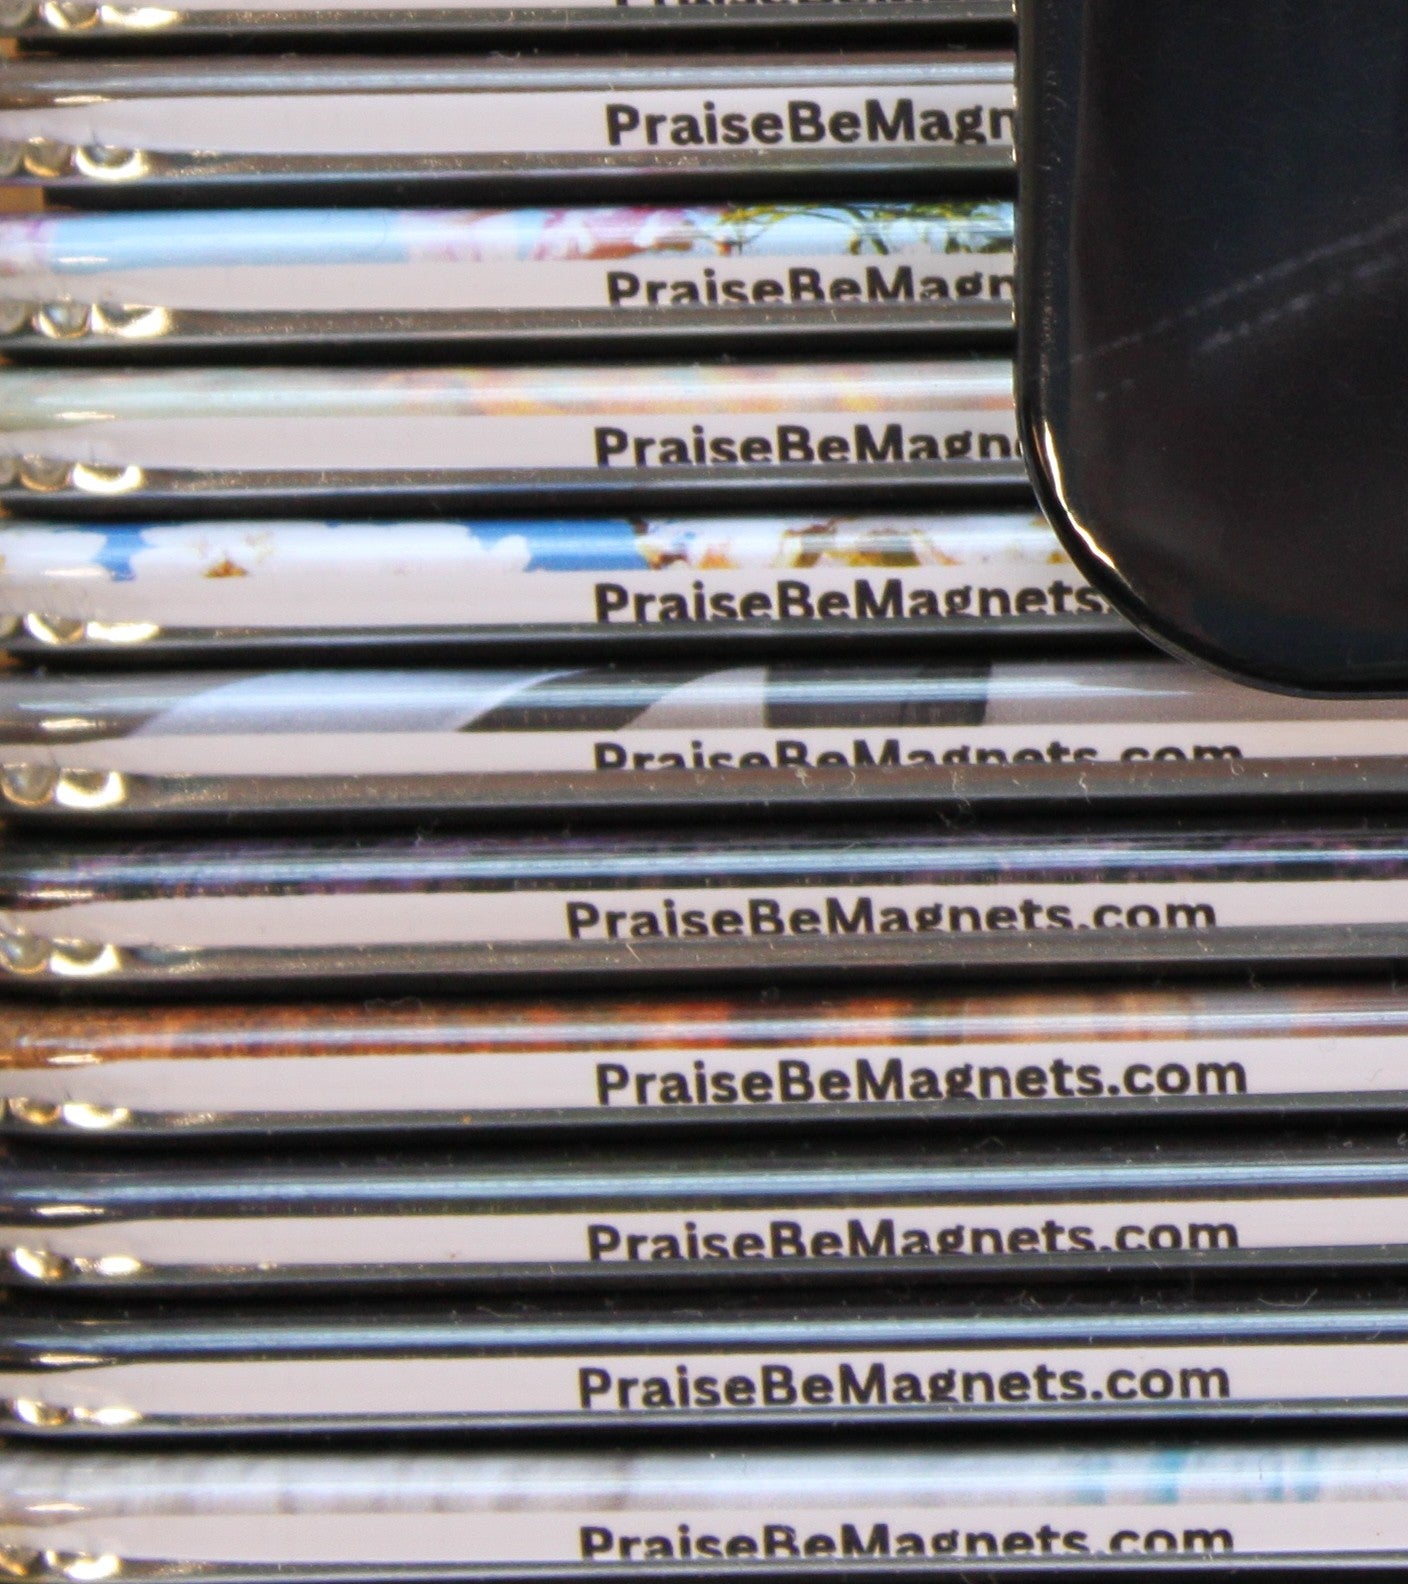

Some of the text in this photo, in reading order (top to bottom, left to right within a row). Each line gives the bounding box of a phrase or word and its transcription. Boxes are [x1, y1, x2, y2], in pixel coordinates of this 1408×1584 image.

[593, 423, 1023, 467] PraiseBeMagn
[565, 895, 1218, 939] PraiseBeMagnets.com
[595, 1057, 1248, 1106] PraiseBeMagnets.com
[586, 1218, 1239, 1261] PraiseBeMagnets.com
[577, 1362, 1231, 1409] PraiseBeMagnets.com
[579, 1523, 1235, 1561] PraiseBeMagnetscom
